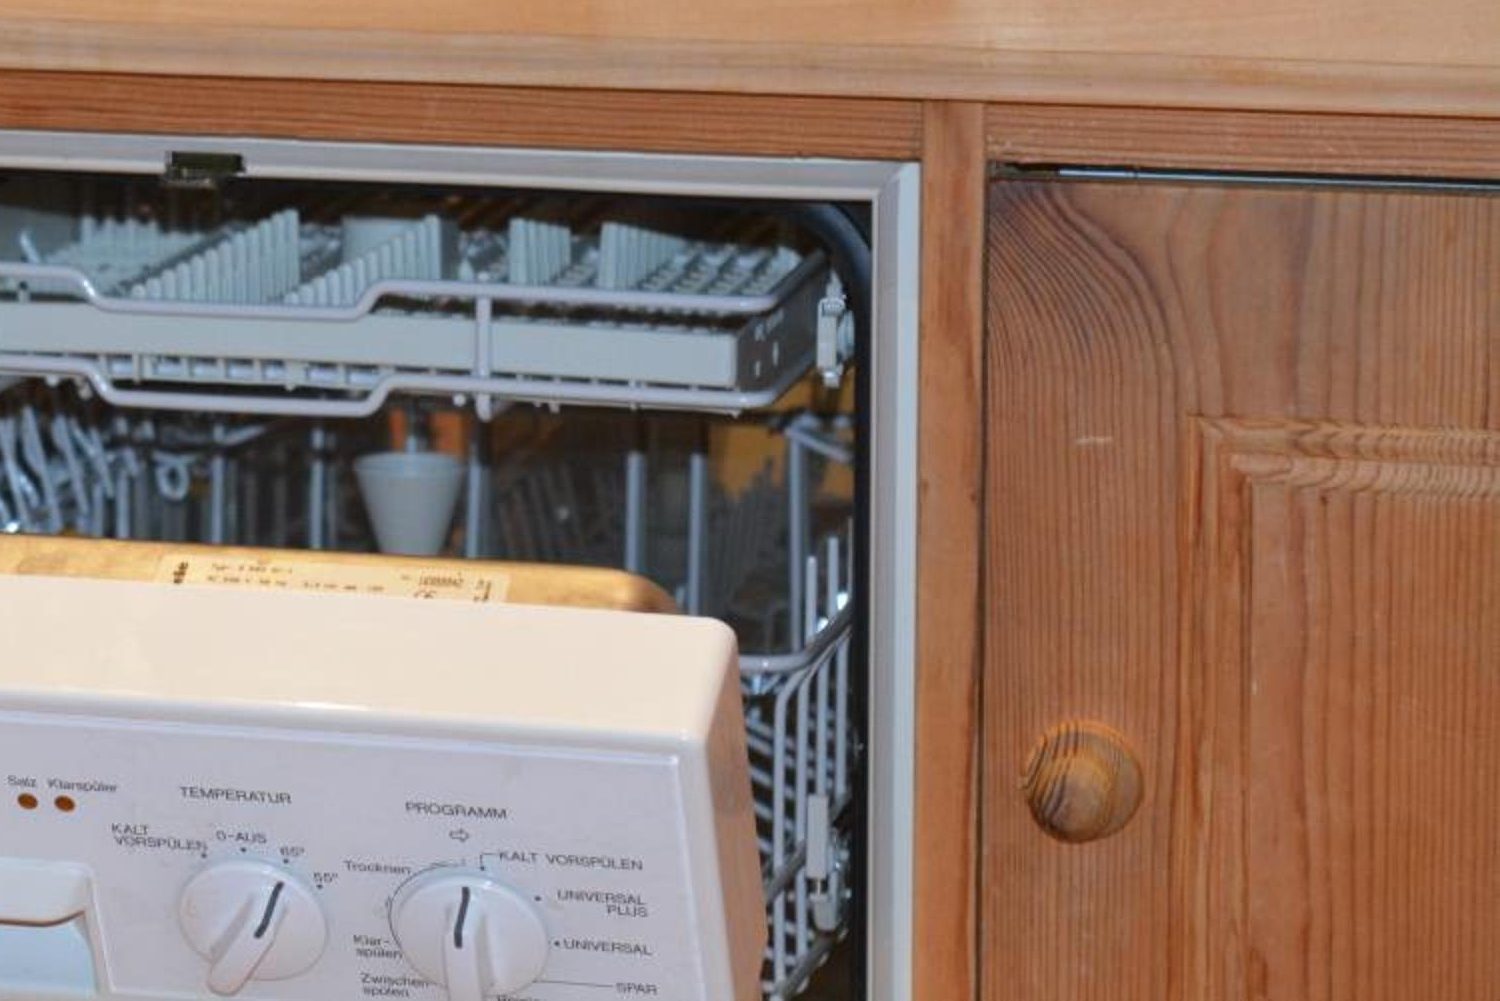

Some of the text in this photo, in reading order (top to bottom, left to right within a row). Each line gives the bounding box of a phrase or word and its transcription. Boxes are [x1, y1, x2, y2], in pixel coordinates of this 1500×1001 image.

[7, 775, 117, 793] Salz Klarspüler
[180, 786, 292, 804] TEMPERATUR
[405, 801, 507, 819] PROGRAMM
[111, 823, 148, 836] KALT
[114, 834, 208, 851] VORSPÜLEN
[344, 860, 412, 875] Trocknen
[500, 851, 643, 871] KALT VORSPÜLEN
[557, 889, 645, 905] UNIVERSAL
[606, 905, 648, 918] PLUS
[356, 948, 403, 960] spülen
[563, 938, 653, 956] UNIVERSAL
[615, 982, 658, 996] SPAR
